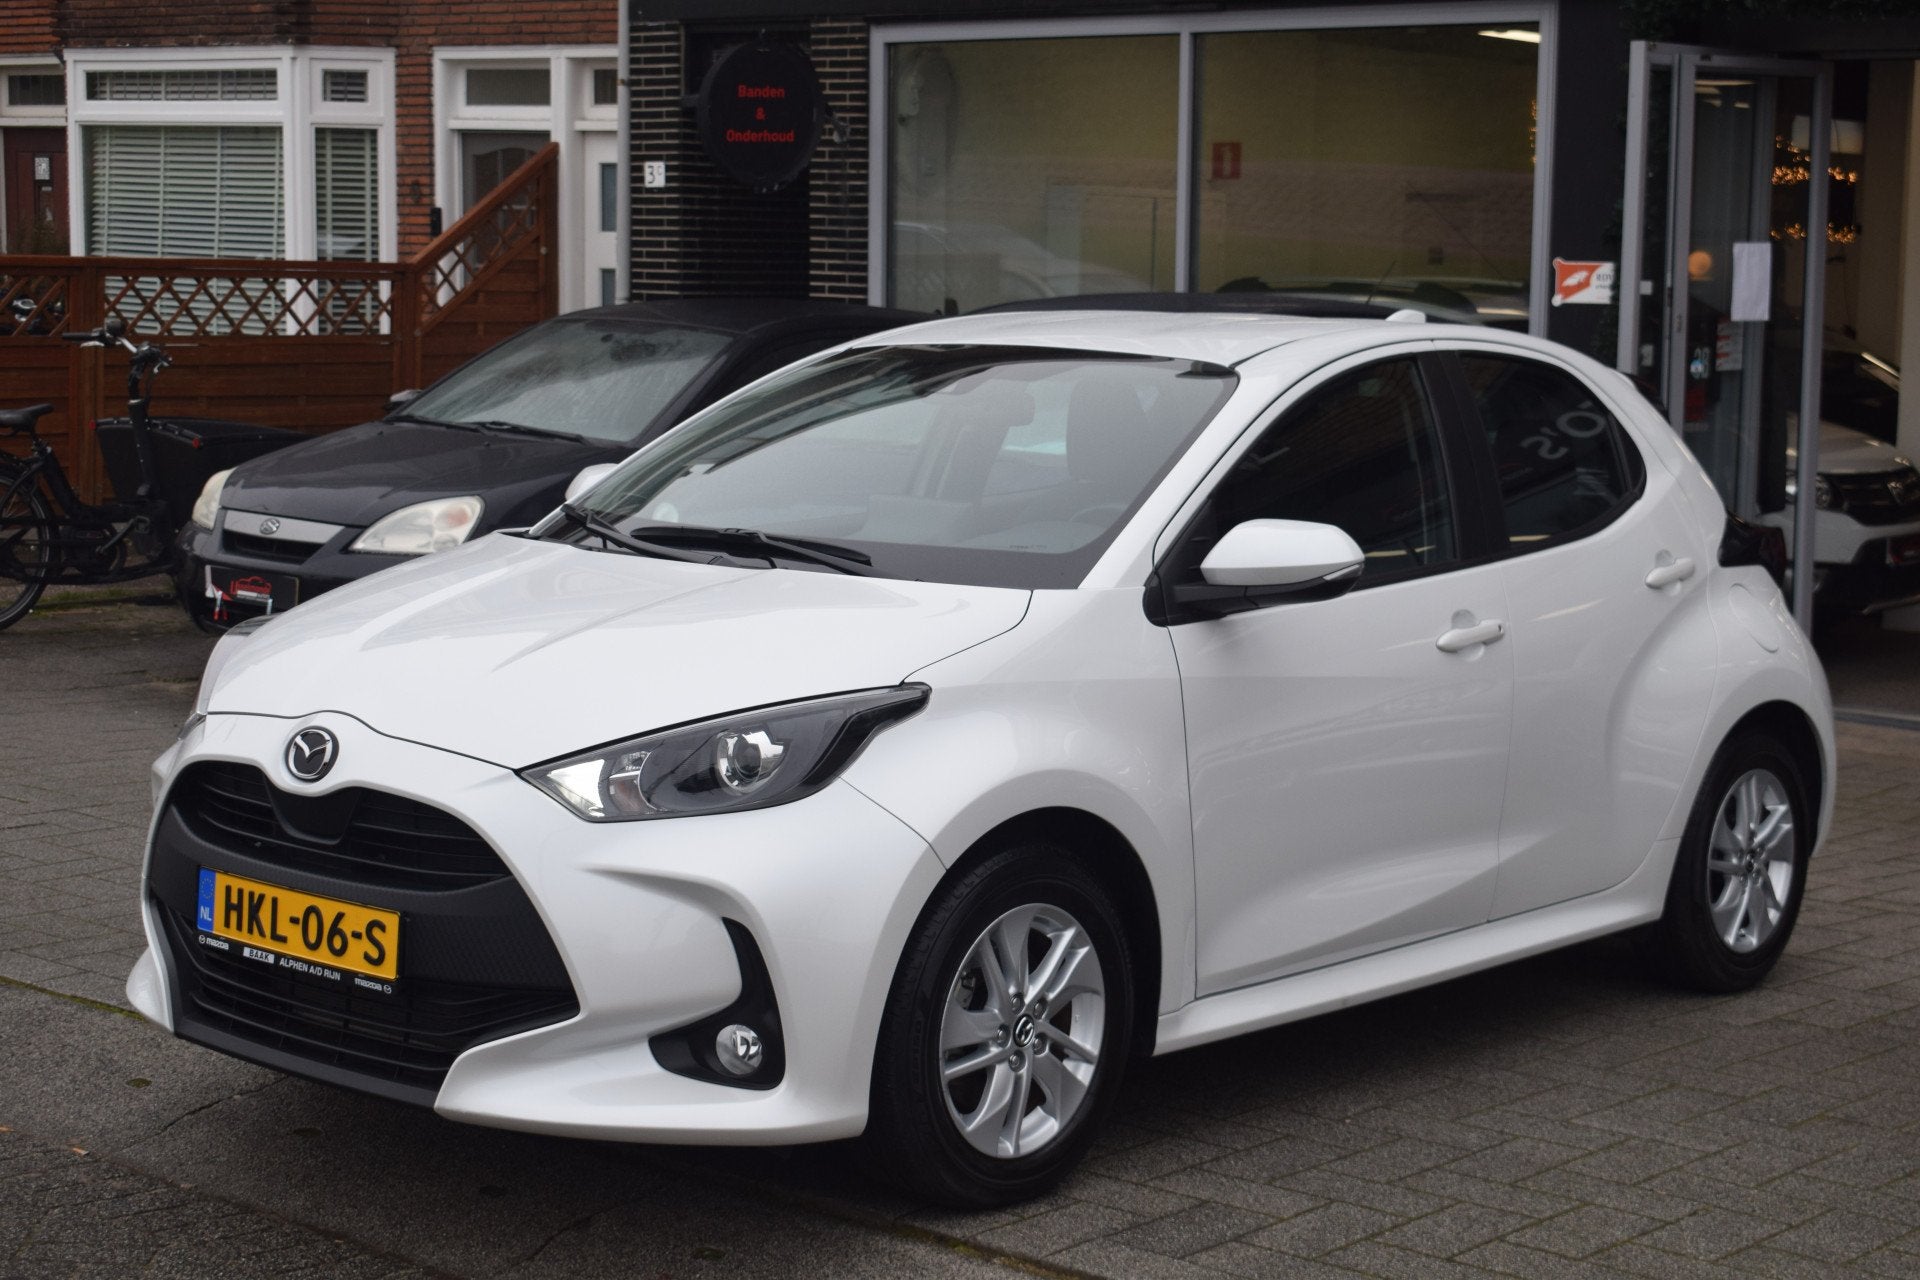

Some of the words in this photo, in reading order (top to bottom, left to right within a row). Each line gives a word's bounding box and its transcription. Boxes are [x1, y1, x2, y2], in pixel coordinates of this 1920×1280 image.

[738, 85, 785, 98] Banden
[755, 107, 766, 120] &
[726, 130, 795, 142] Onderhoud
[200, 905, 212, 922] NL
[223, 884, 386, 967] HKL-06-S
[249, 948, 269, 961] BAAK
[279, 956, 309, 972] ALPHEN
[309, 963, 324, 977] A/D
[324, 968, 341, 982] RIJN
